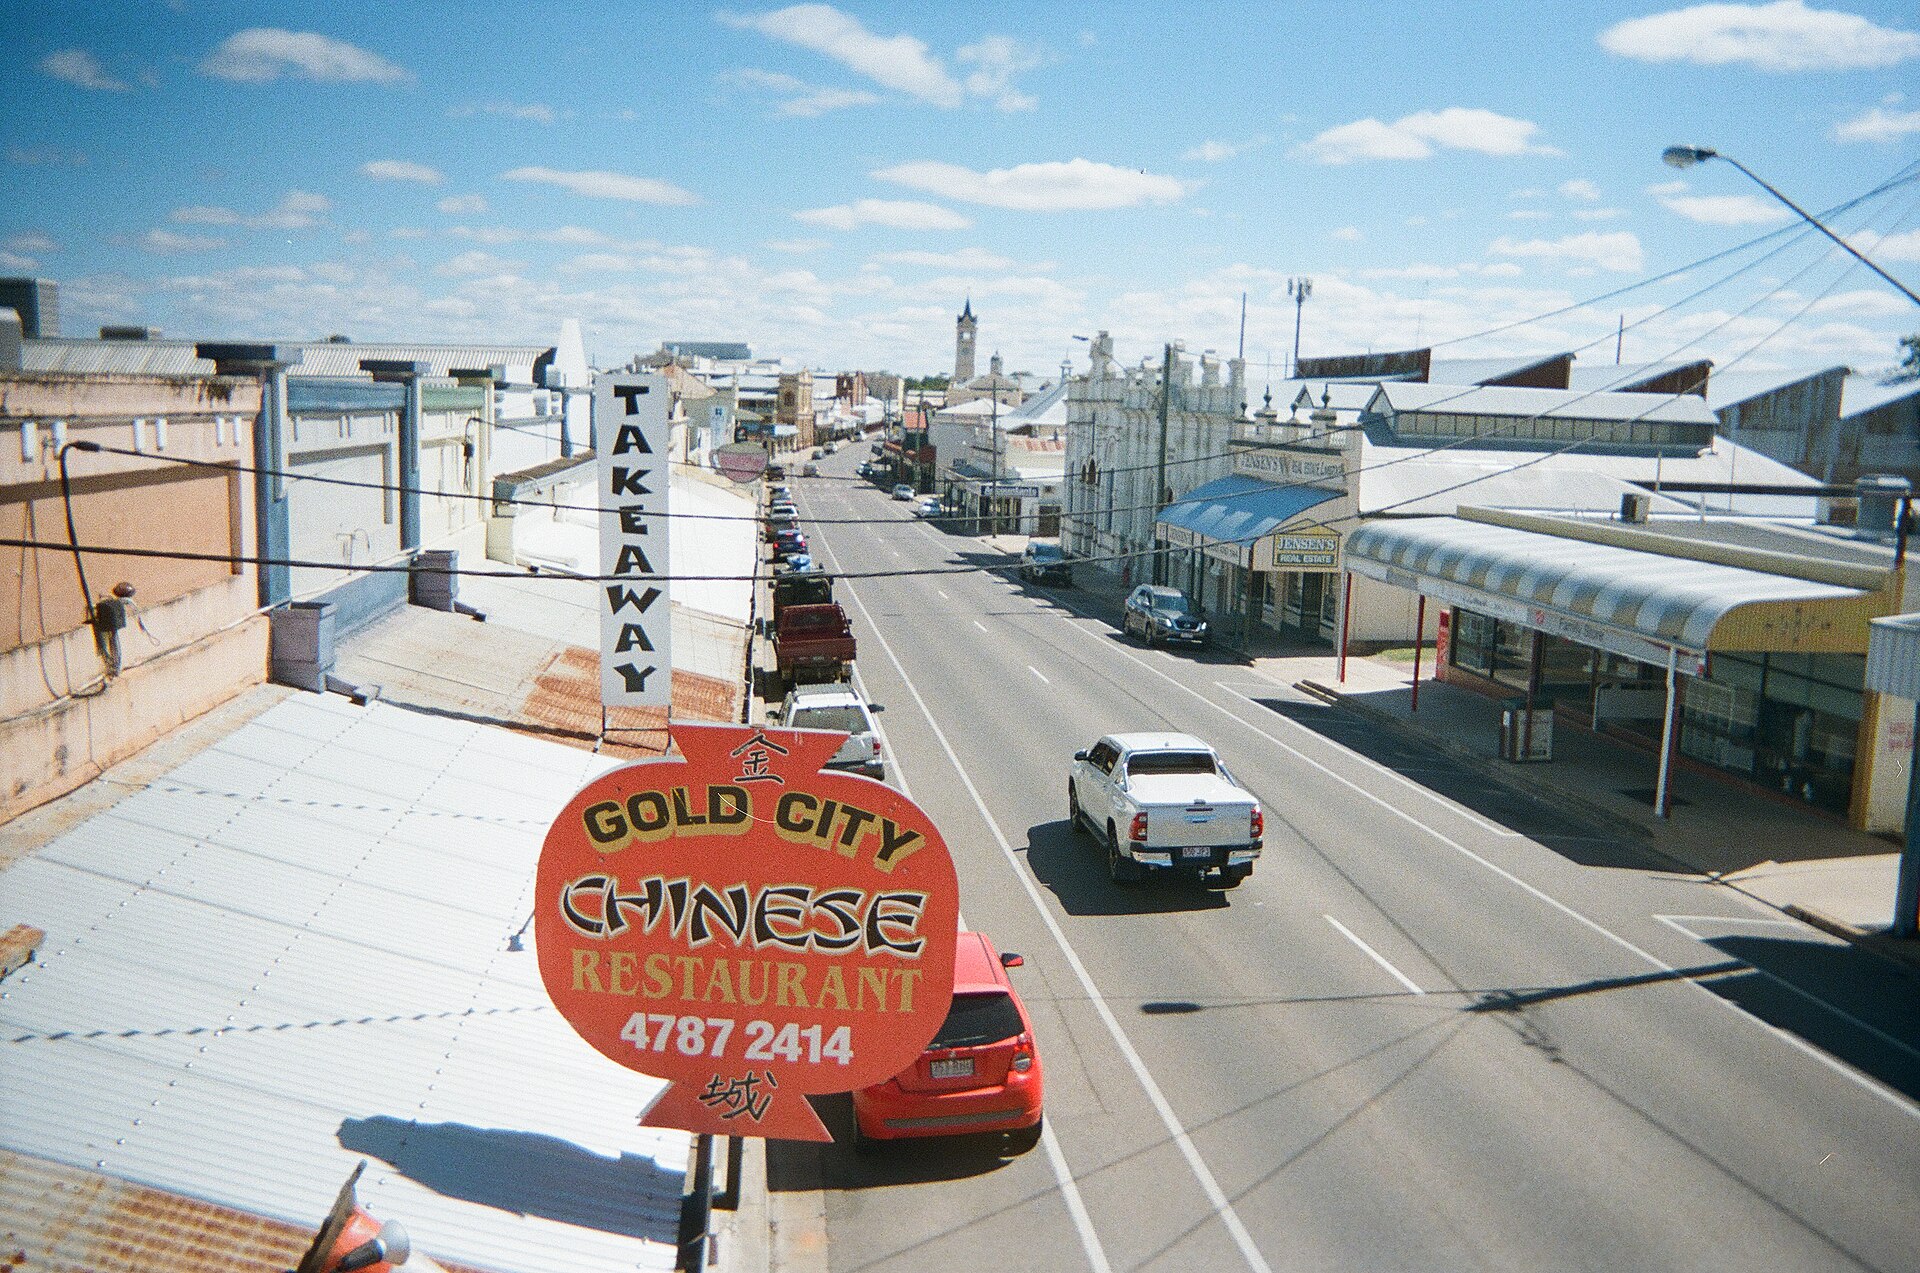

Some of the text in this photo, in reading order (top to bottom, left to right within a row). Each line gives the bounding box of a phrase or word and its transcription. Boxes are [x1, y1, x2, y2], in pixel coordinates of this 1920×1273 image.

[605, 384, 663, 693] TAKEAWAY
[1278, 537, 1336, 551] JENSEN'S
[1280, 554, 1333, 565] REAL ESTATE
[731, 733, 789, 784] 金
[583, 785, 926, 873] GOLD CITY
[559, 875, 927, 958] CHINESE
[571, 949, 923, 1013] RESTAURANT
[621, 1012, 854, 1066] 4787 2414
[698, 1069, 778, 1123] 城
